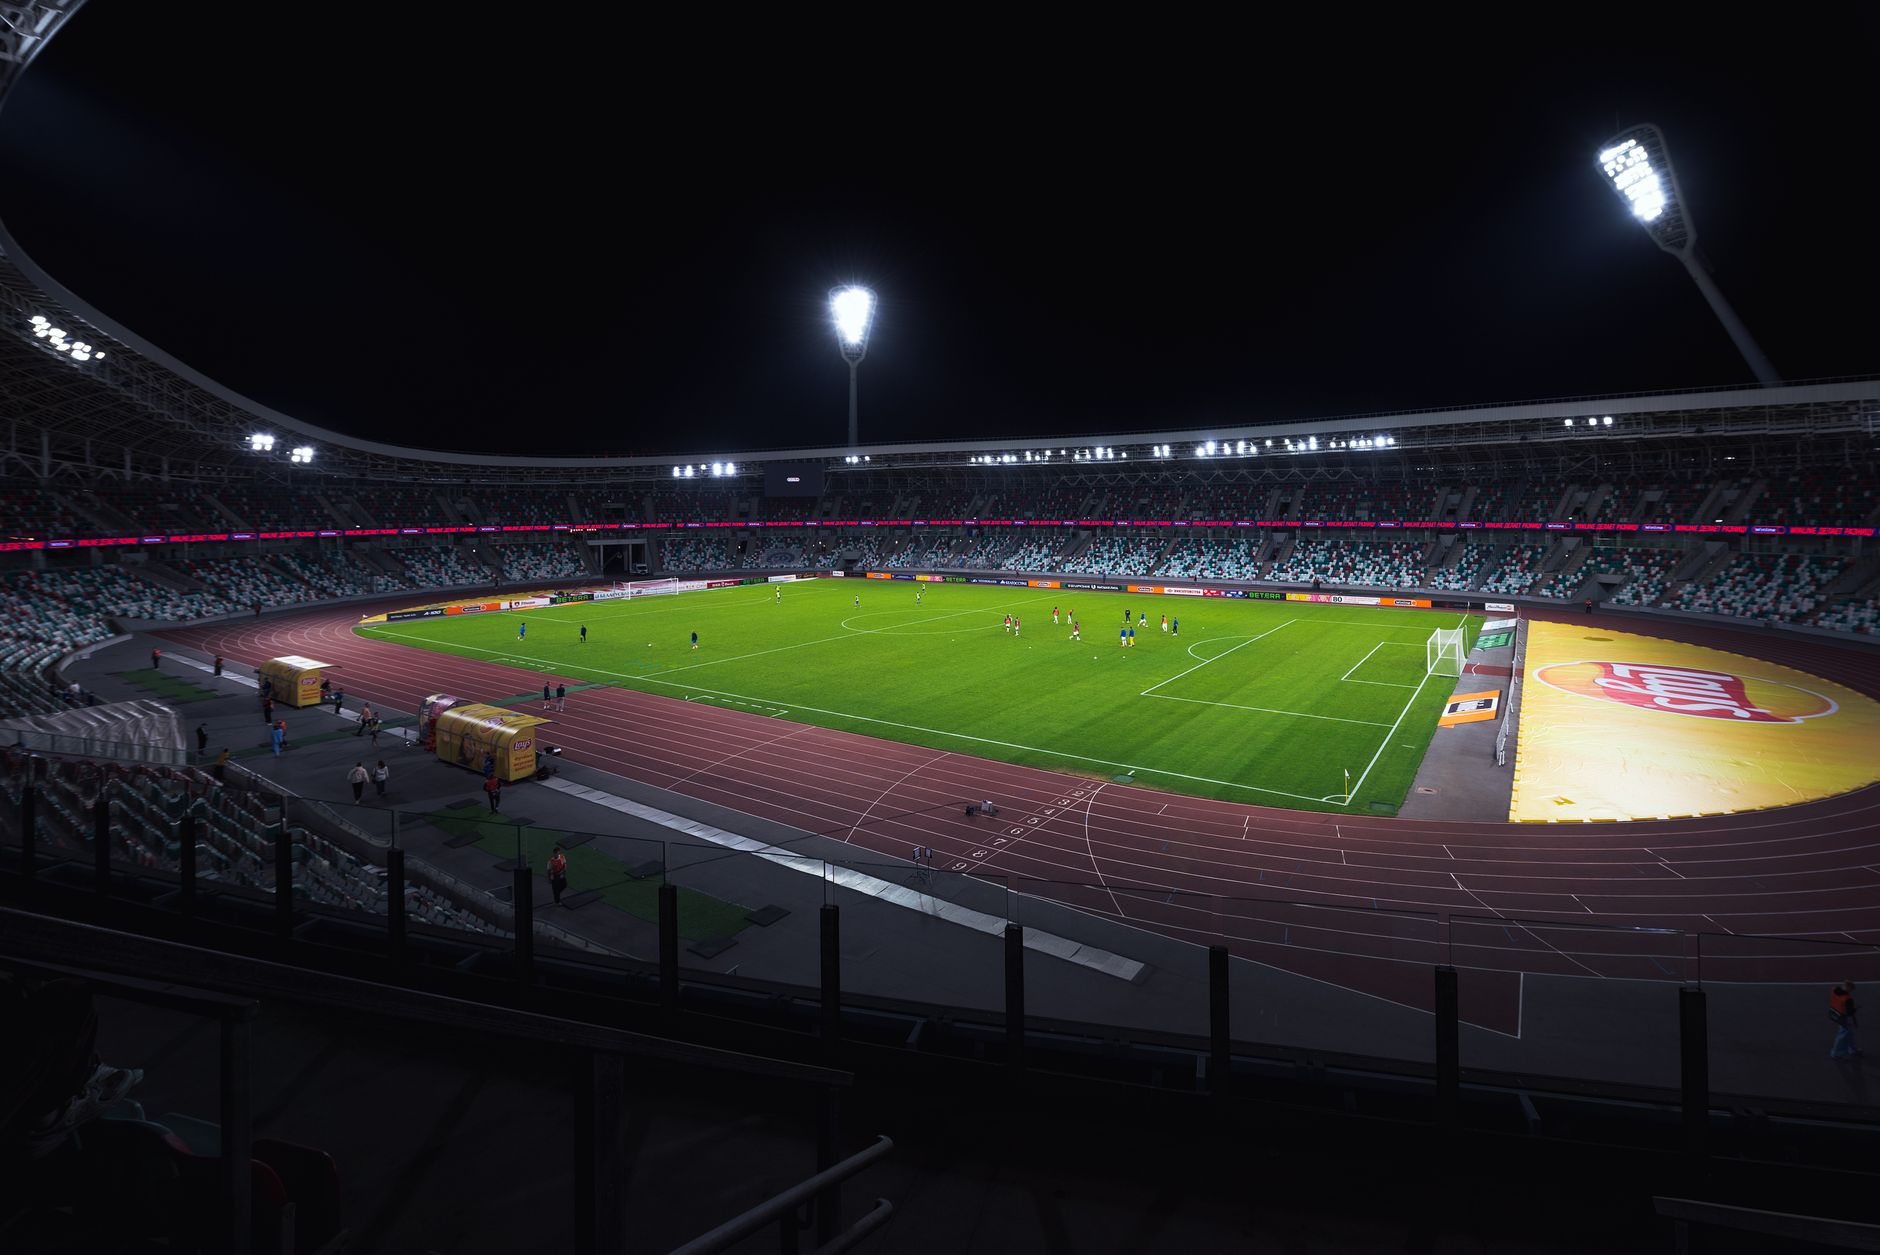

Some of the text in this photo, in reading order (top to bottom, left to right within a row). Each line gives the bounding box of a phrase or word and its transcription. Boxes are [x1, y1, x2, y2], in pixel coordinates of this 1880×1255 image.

[1594, 663, 1772, 719] Lay's
[1010, 827, 1024, 835] 6
[993, 838, 1008, 846] 7
[972, 849, 988, 858] 8
[951, 862, 967, 871] 9
